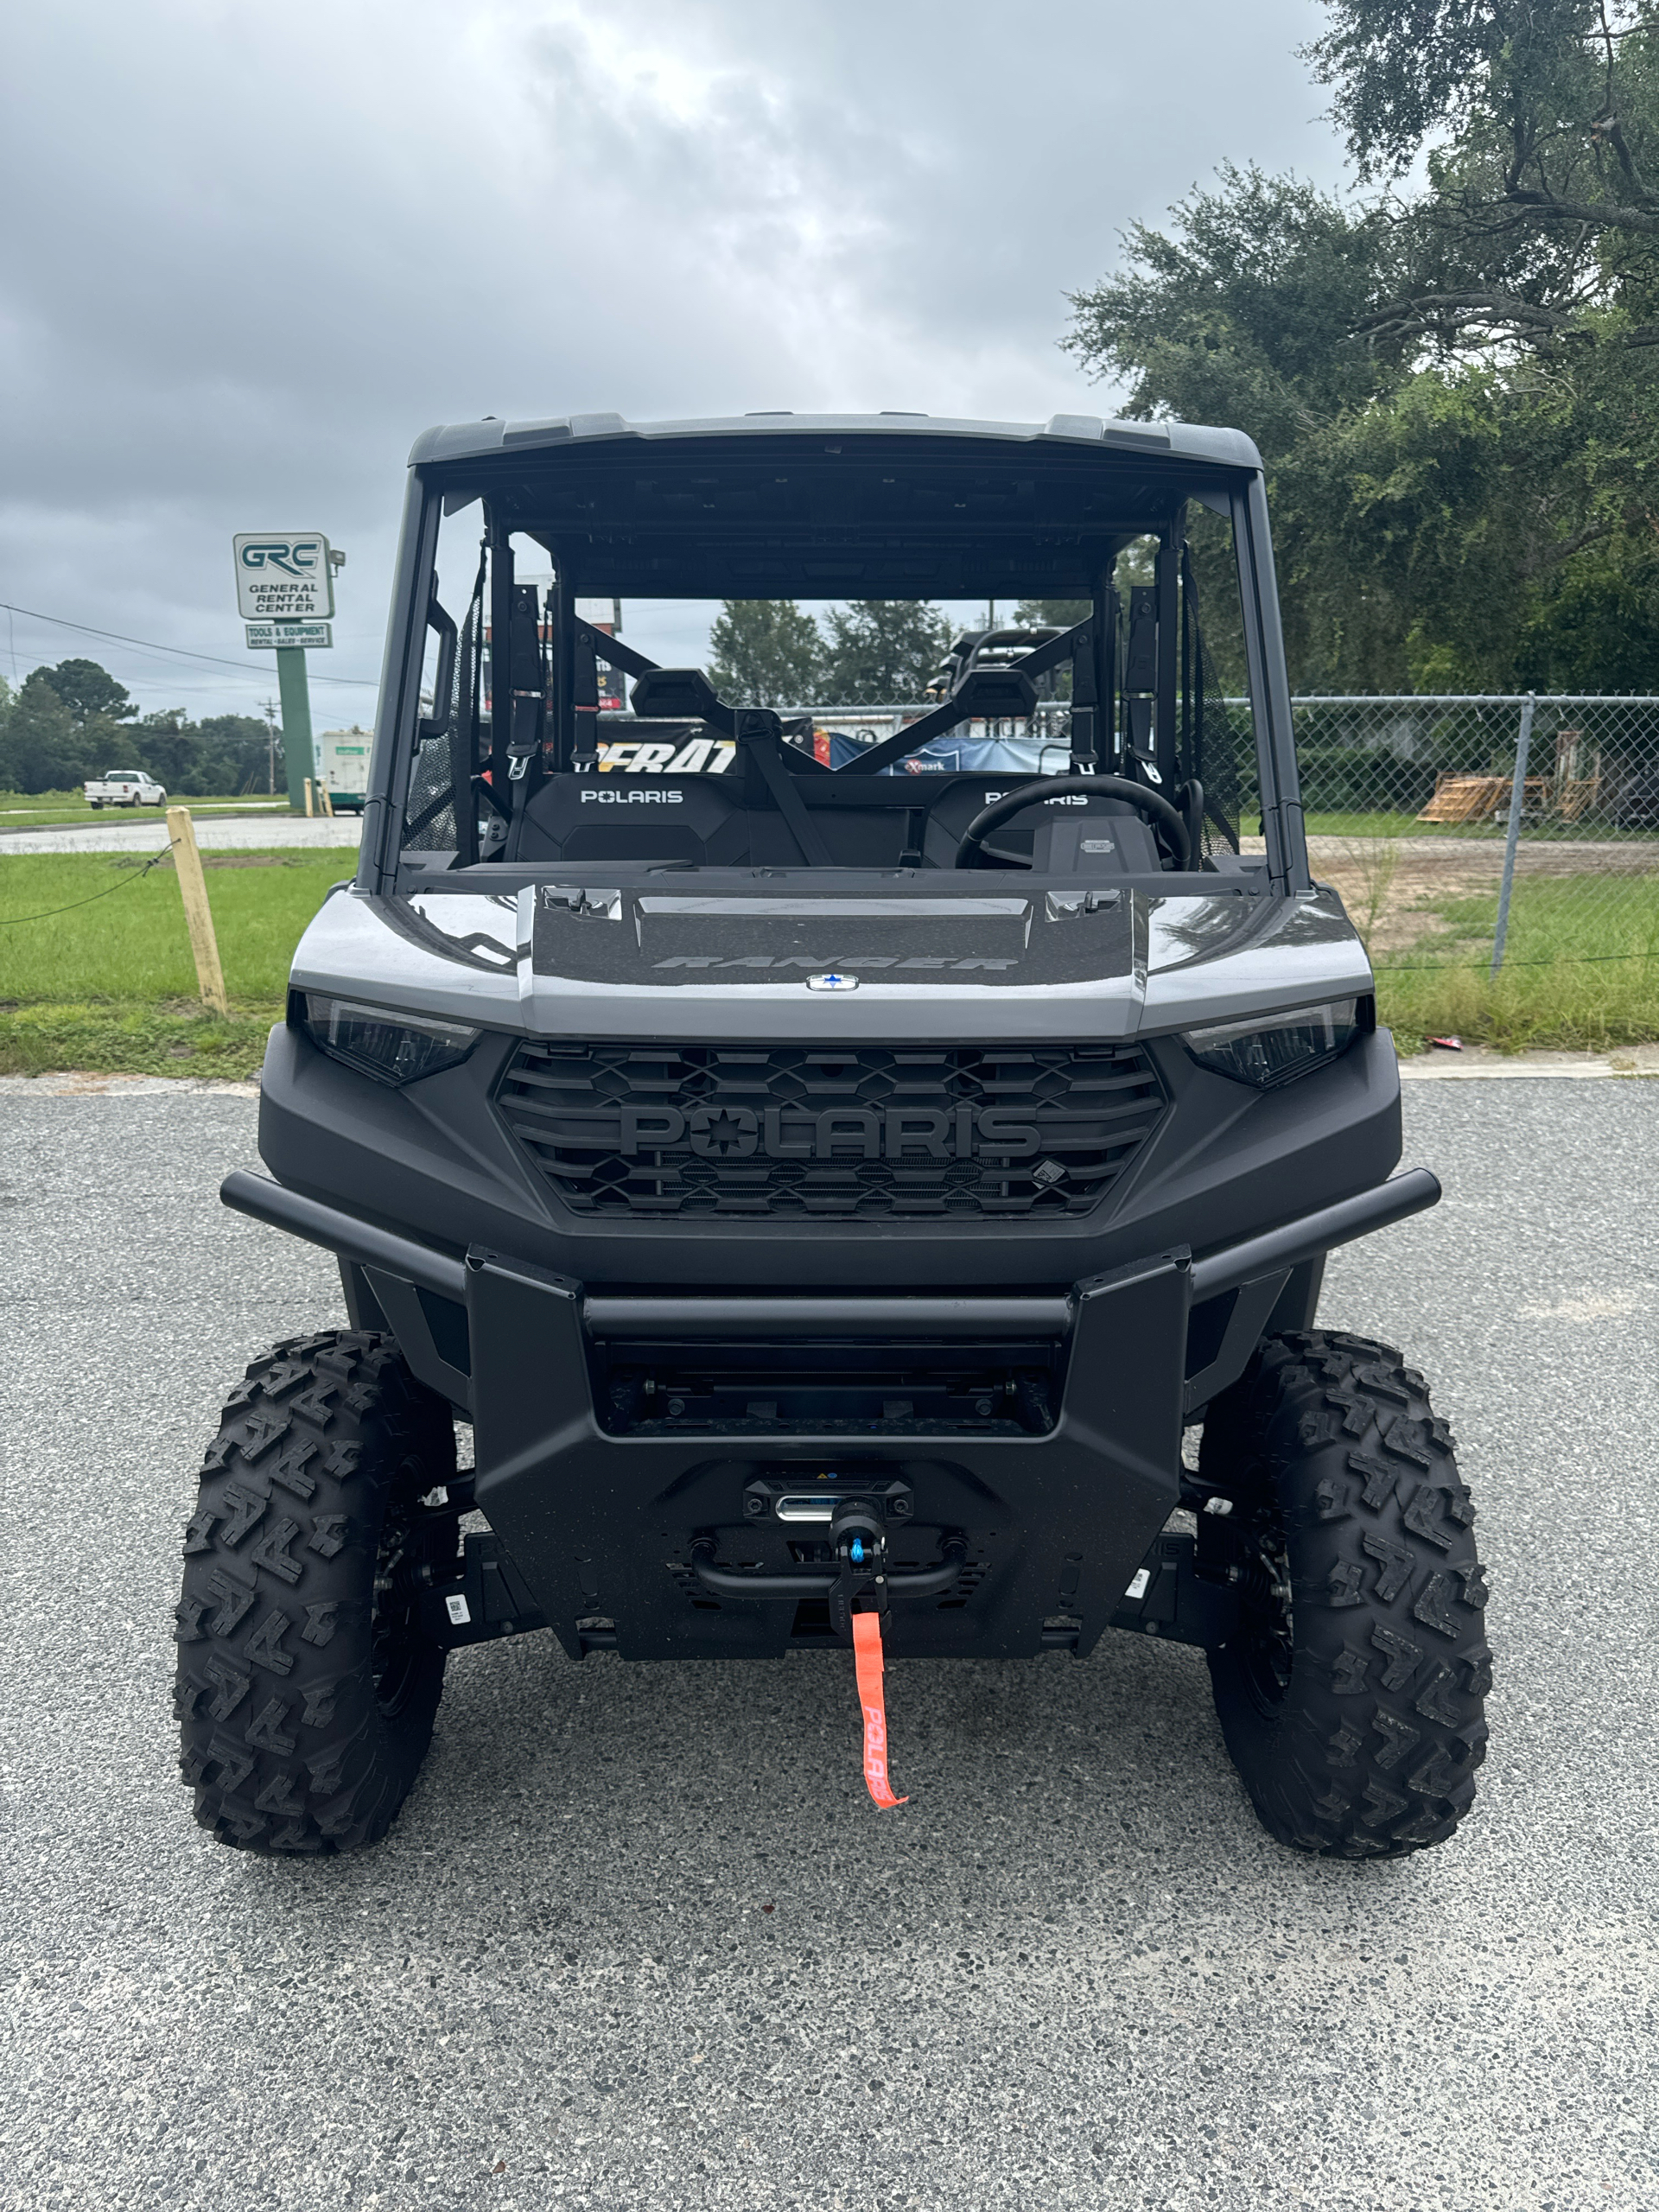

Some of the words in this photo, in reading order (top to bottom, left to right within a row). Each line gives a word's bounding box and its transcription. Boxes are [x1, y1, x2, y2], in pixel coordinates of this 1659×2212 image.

[241, 543, 318, 576] GRC
[249, 584, 319, 593] GENERAL
[256, 594, 313, 603] RENTAL
[255, 603, 315, 613] CENTER
[248, 627, 272, 637] TOOLS
[275, 627, 281, 637] &
[283, 626, 325, 636] EQUIPMENT
[581, 790, 683, 804] POLARIS
[985, 791, 1089, 805] PRIS
[651, 956, 1019, 970] RANGER
[620, 1104, 1042, 1159] POLARIS
[864, 1705, 893, 1802] POLARIS
